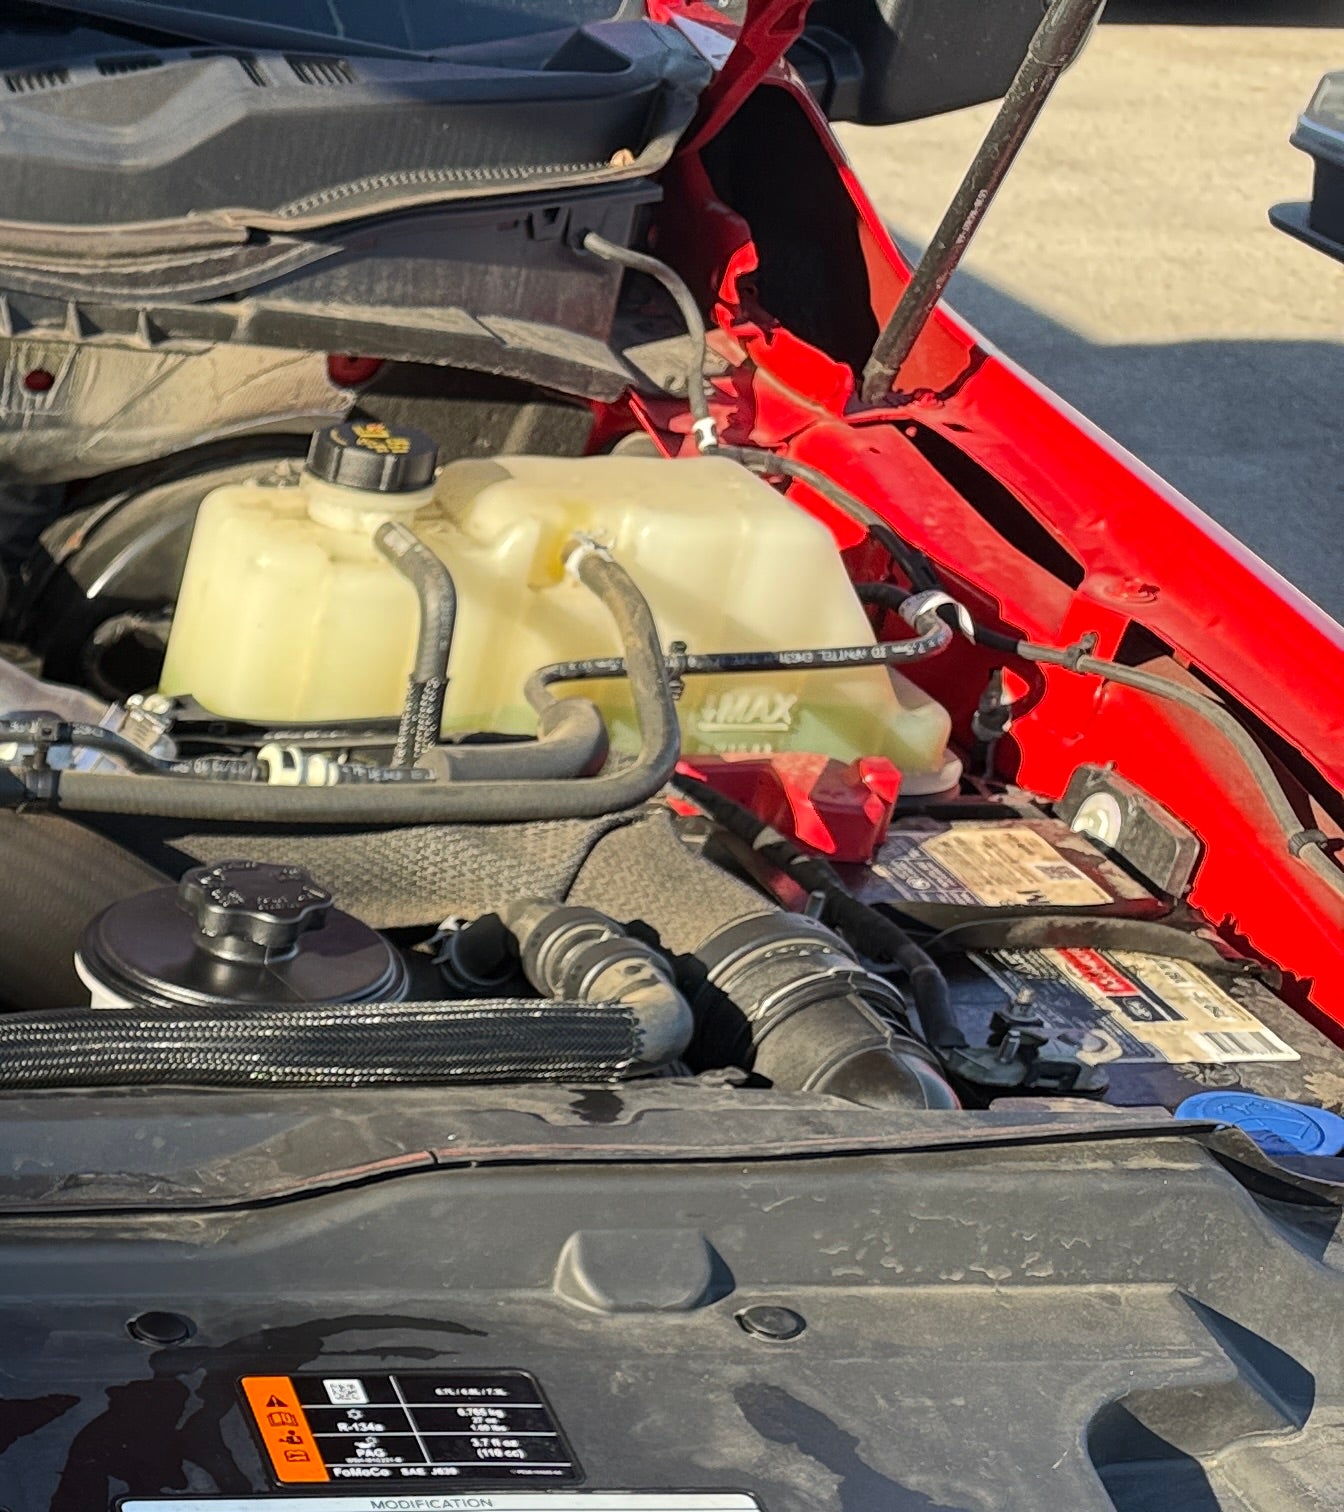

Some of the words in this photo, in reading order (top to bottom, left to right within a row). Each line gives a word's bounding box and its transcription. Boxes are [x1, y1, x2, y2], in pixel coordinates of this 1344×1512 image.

[336, 1421, 385, 1432] R-134a
[470, 1437, 490, 1447] 3.7
[355, 1447, 388, 1458] PAG
[332, 1466, 392, 1477] FoMoCo
[370, 1498, 493, 1510] MODIFICATION
